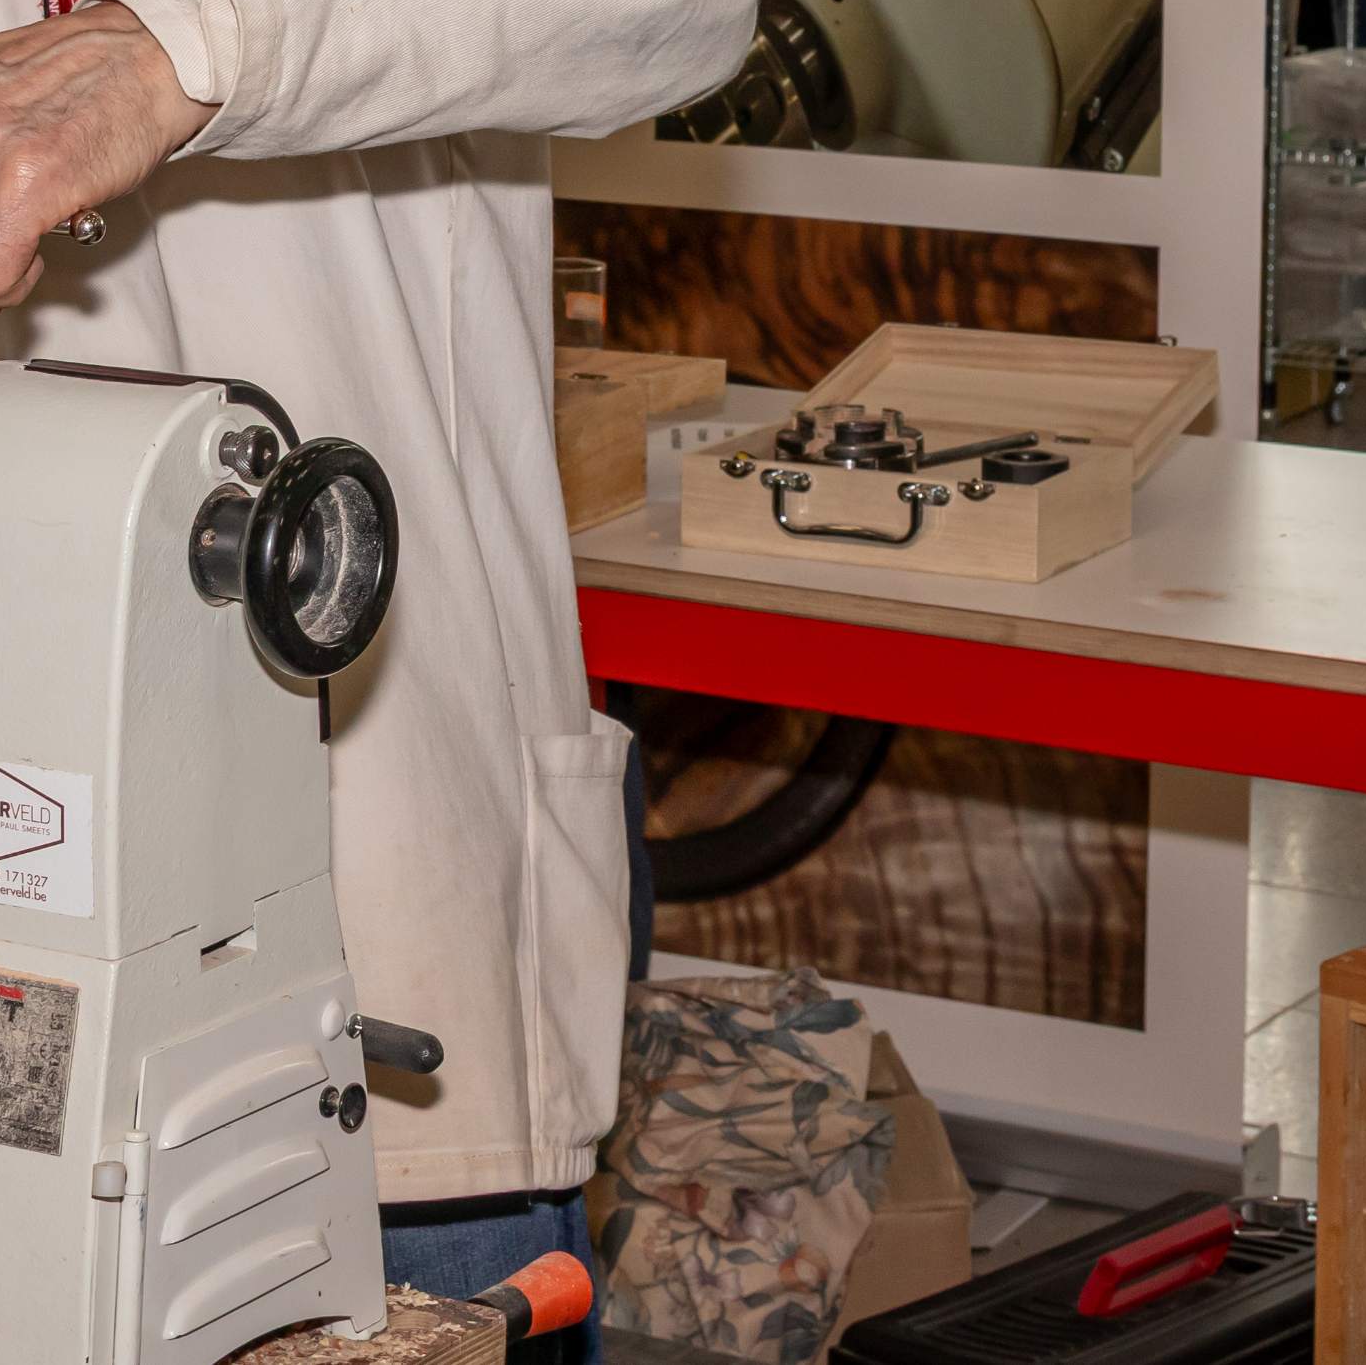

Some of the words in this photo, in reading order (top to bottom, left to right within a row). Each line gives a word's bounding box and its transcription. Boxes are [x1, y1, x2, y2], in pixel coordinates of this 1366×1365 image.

[0, 821, 20, 832] PAUL
[21, 824, 51, 836] SMEETS
[5, 869, 48, 888] 171327
